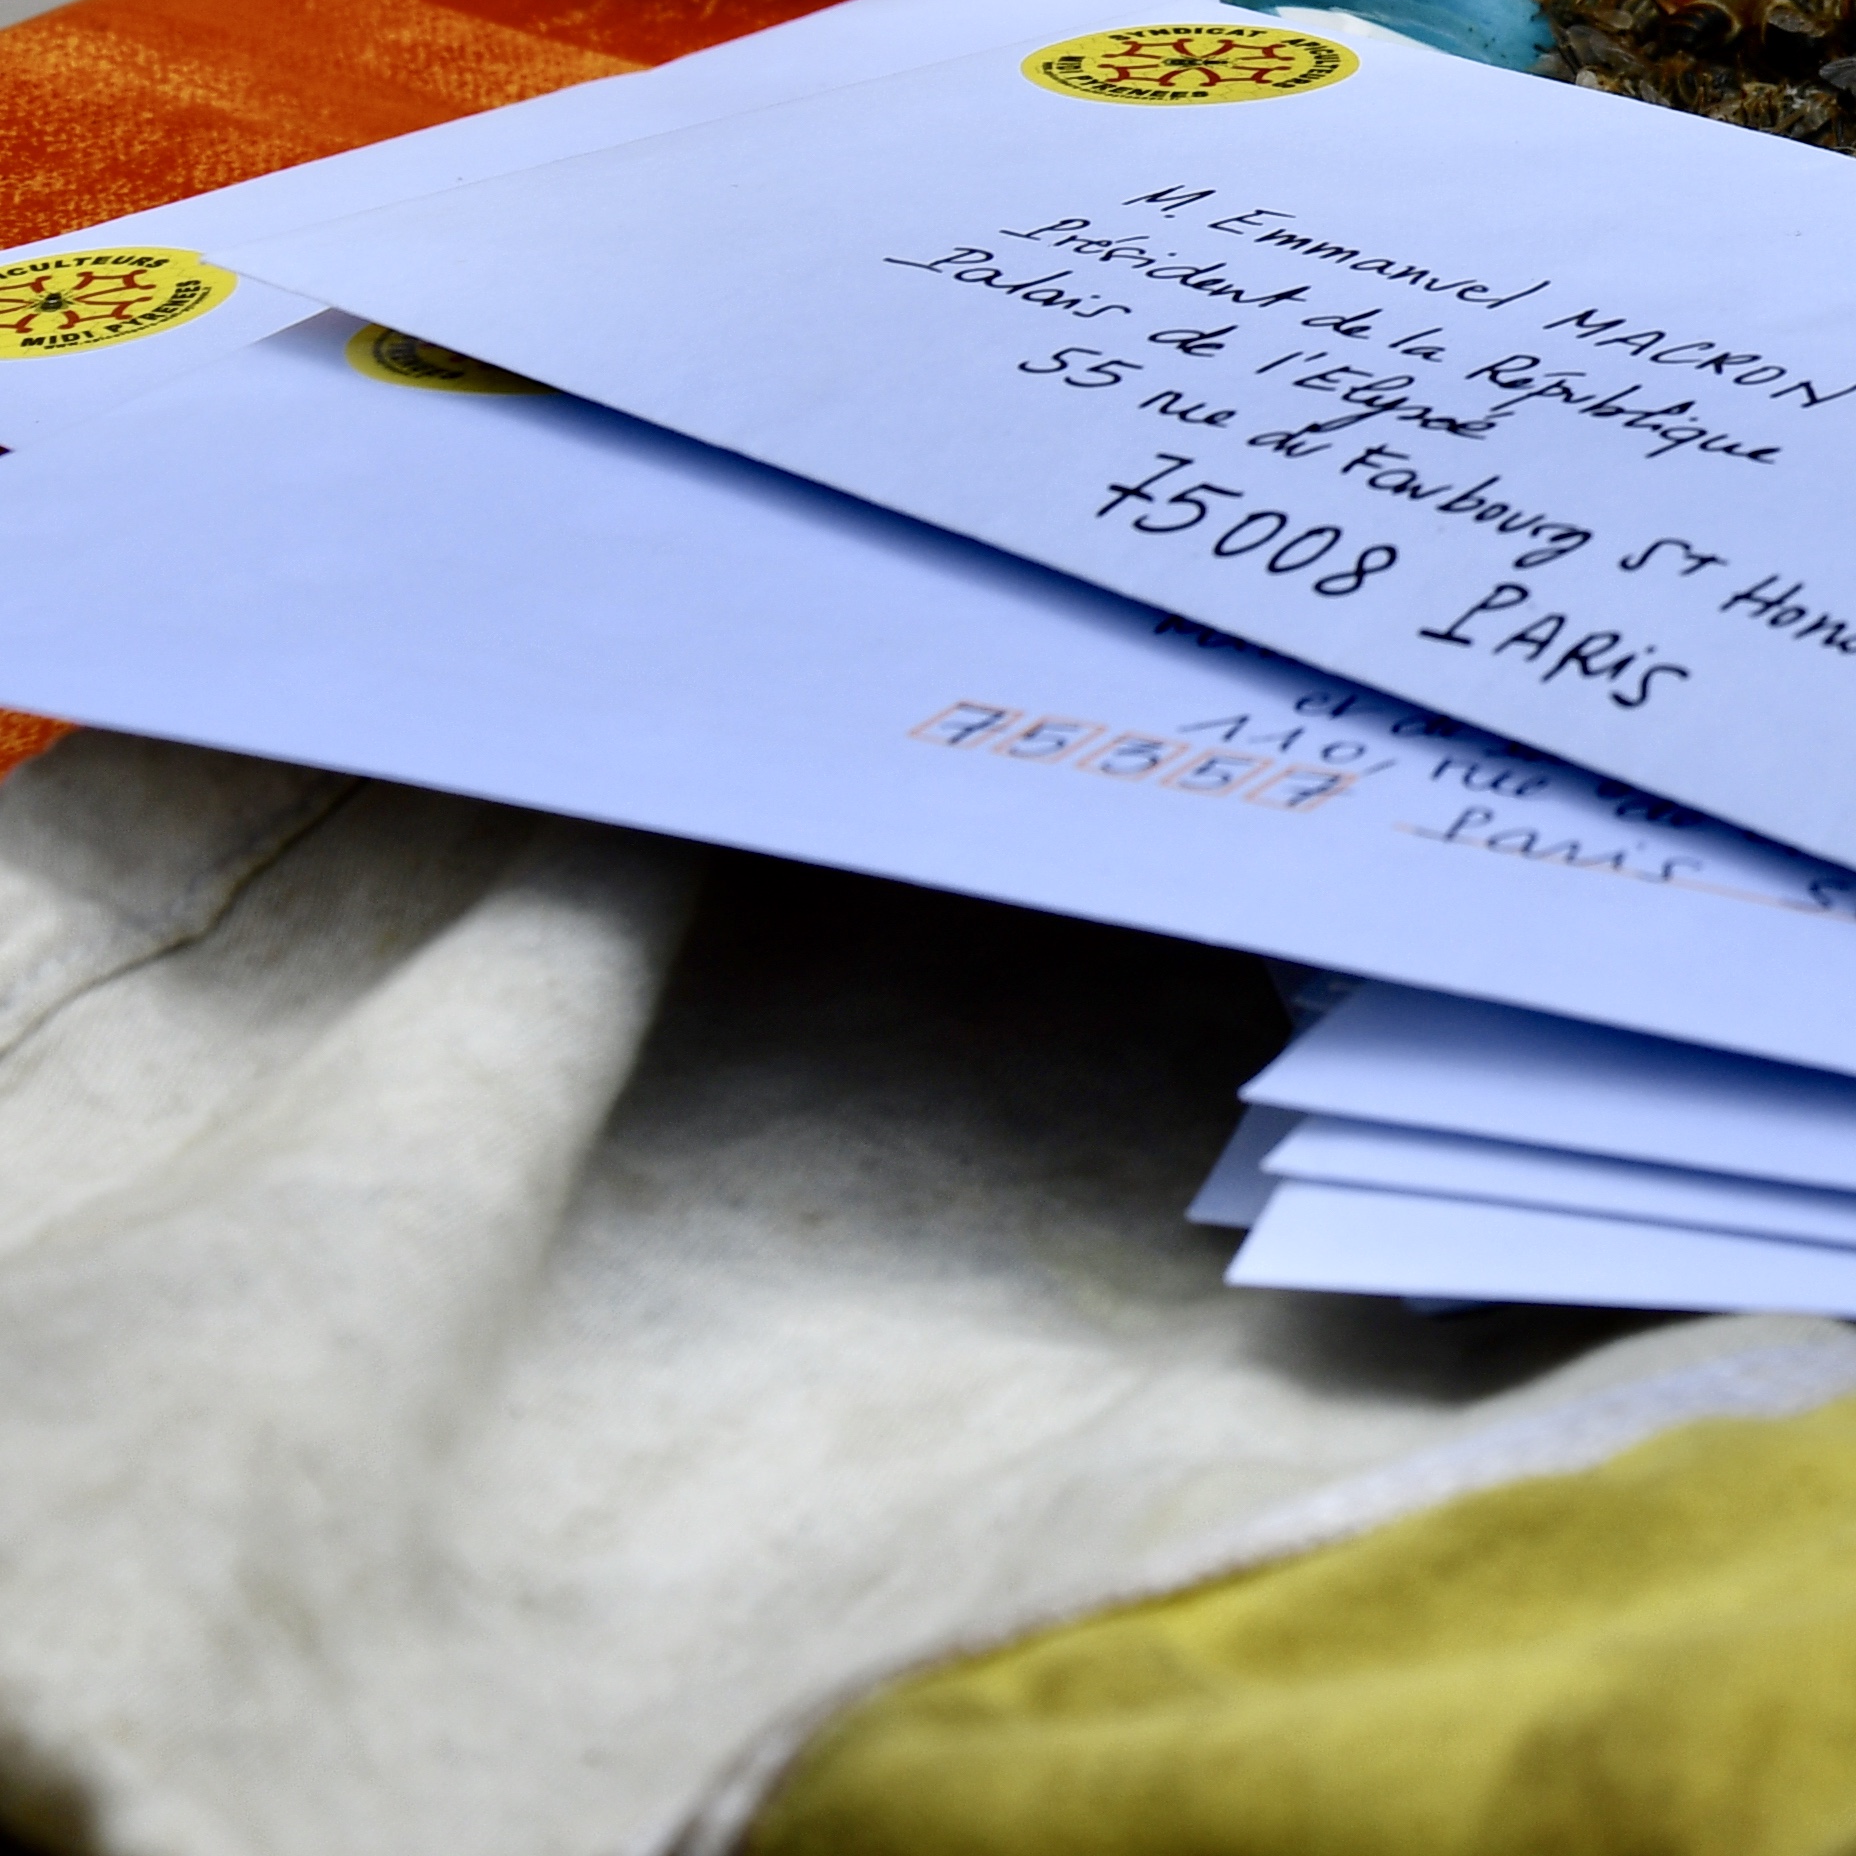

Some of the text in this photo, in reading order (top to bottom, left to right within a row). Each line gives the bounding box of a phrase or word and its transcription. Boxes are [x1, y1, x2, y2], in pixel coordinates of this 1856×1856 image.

[1107, 26, 1268, 42] SYNDICAT
[883, 246, 1132, 319] Palais
[1147, 324, 1239, 358] de
[1207, 208, 1551, 311] Emmanuel
[20, 330, 95, 347] MIDI
[104, 279, 203, 333] PYRENEES
[1300, 308, 1383, 340] de
[1388, 327, 1445, 363] la
[1018, 347, 1144, 388] 55
[1138, 389, 1238, 429] rue
[1247, 425, 1333, 459] du
[1096, 452, 1398, 596] 75008
